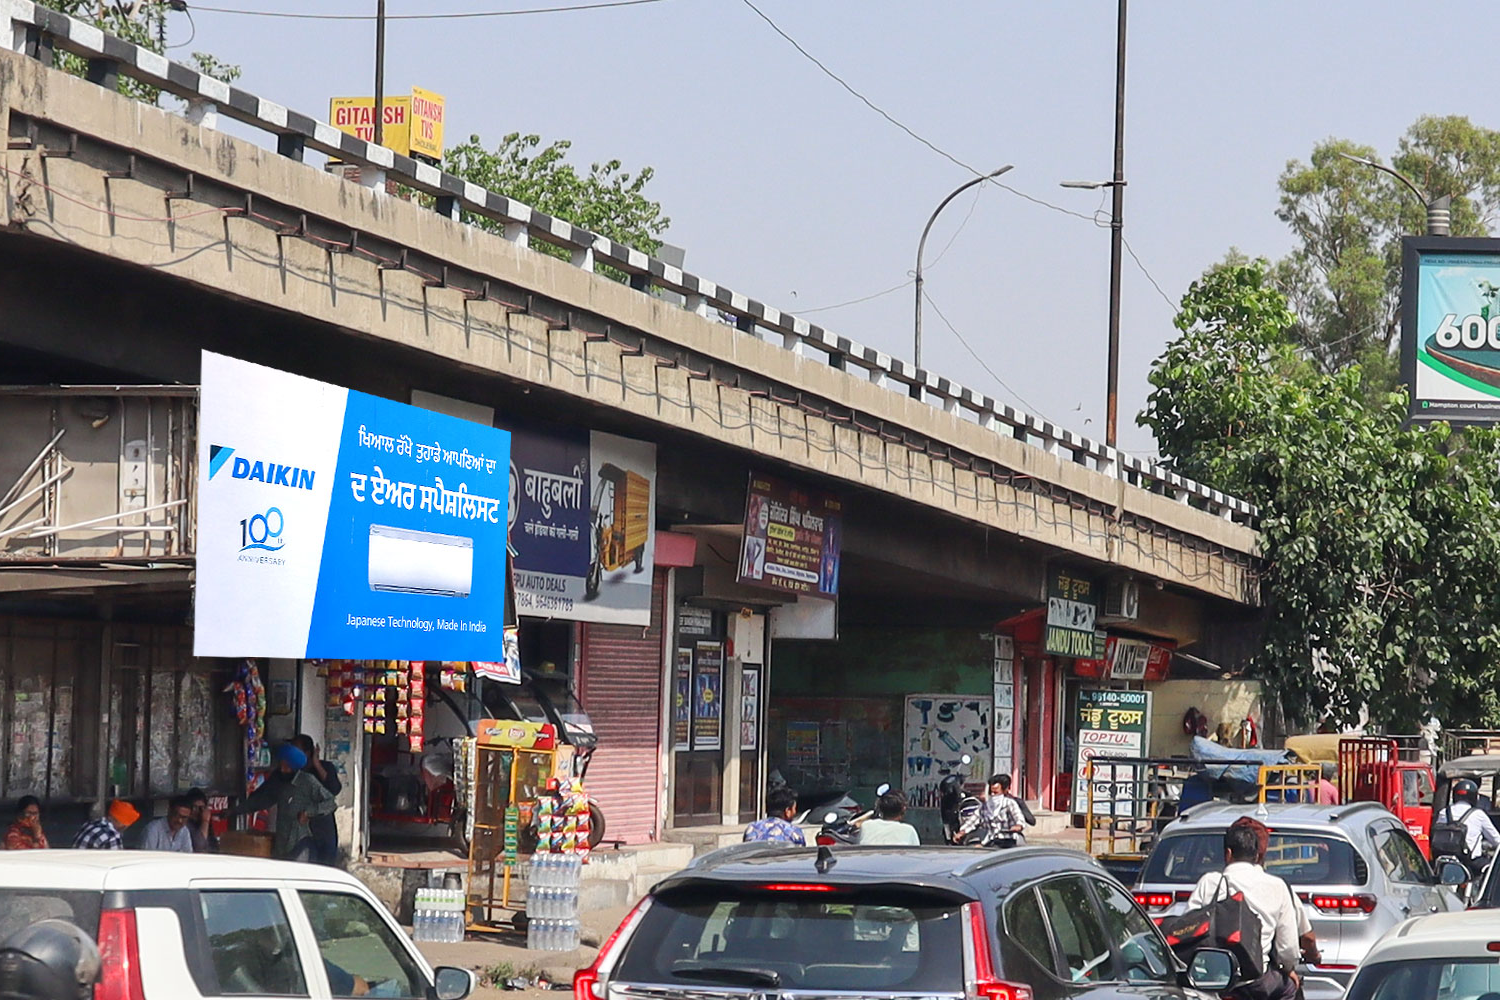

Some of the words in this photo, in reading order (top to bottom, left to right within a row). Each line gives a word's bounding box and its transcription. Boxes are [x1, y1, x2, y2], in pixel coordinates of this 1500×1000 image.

[336, 106, 404, 125] GITASH
[413, 96, 443, 123] GITANSH
[421, 119, 434, 140] TVS
[358, 425, 395, 453] ਖਿਆਲ
[416, 442, 441, 463] ਤੁਹਾਡੇ
[443, 448, 485, 471] ਆਪਣਿਆਂ
[486, 458, 497, 474] ਦਾ
[232, 457, 316, 490] DAIKIN
[350, 472, 368, 502] ਦ
[370, 466, 417, 510] ਏਅਰ
[523, 464, 584, 519] बाहुबली
[526, 575, 545, 591] AUTO
[545, 578, 567, 593] DEALS
[346, 613, 386, 628] Japanese
[388, 616, 435, 632] Technology,
[437, 618, 459, 631] Made
[460, 620, 467, 631] In
[468, 620, 487, 632] India
[1046, 626, 1071, 654] JANDU
[1071, 631, 1094, 657] TOOLS
[1083, 732, 1129, 744] TOPTUL
